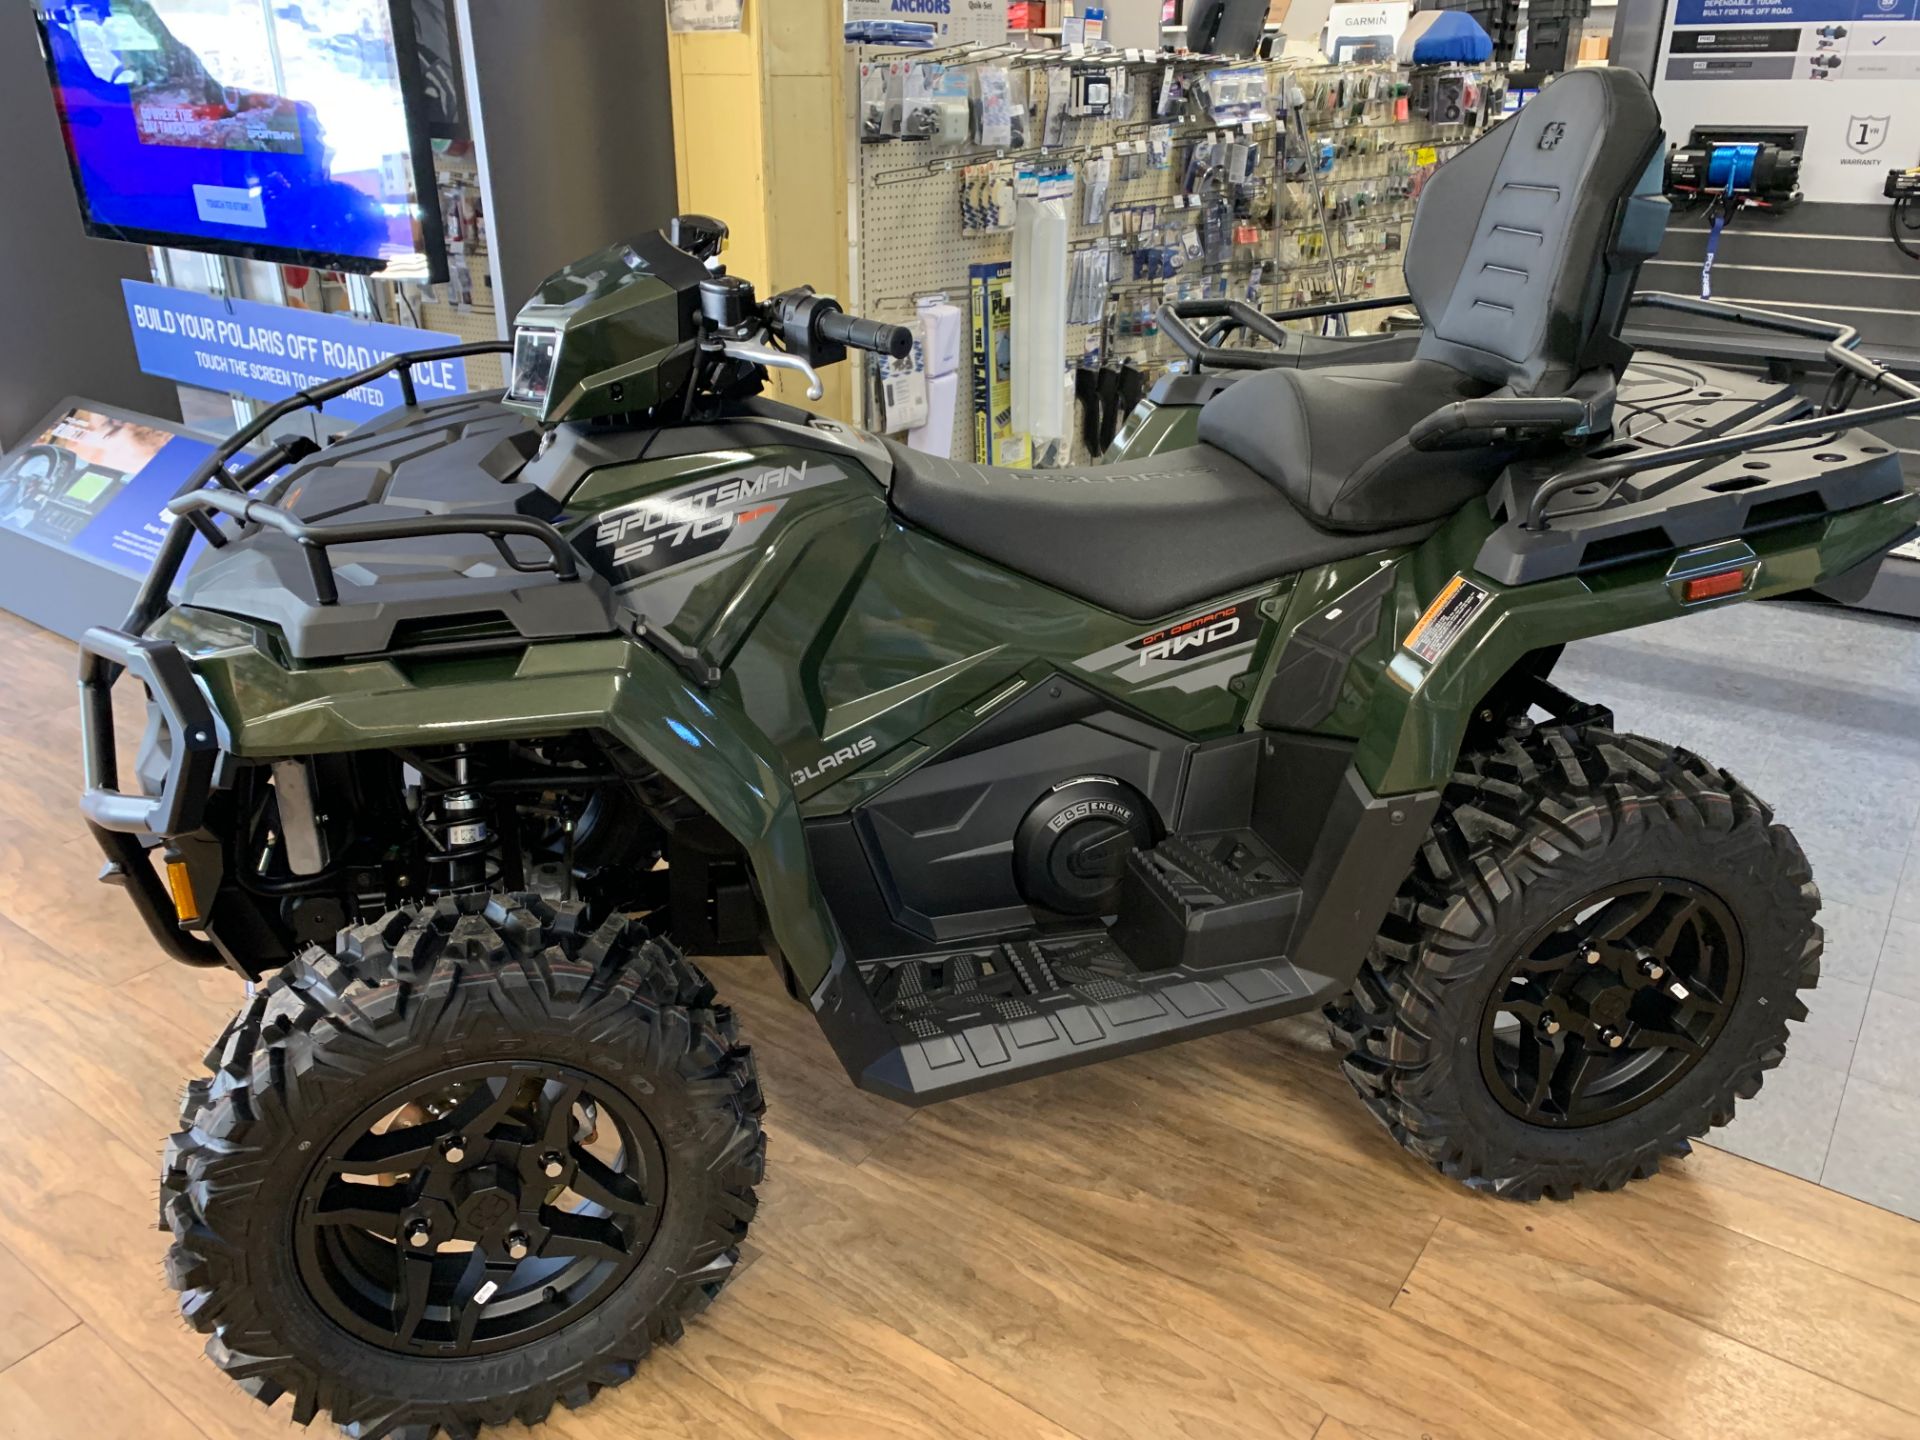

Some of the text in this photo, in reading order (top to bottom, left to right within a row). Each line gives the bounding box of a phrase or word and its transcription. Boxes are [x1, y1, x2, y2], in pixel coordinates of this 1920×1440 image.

[891, 0, 950, 14] ANCHORS
[1345, 16, 1387, 26] GARMIN
[1855, 124, 1868, 145] 1
[133, 304, 176, 334] BUILD
[176, 312, 217, 343] YOUR
[217, 320, 285, 356] POLARIS
[286, 333, 318, 363] OFF
[322, 340, 372, 372] ROAD
[974, 327, 983, 348] THE
[195, 351, 228, 372] TOUCH
[228, 358, 249, 378] THE
[250, 363, 292, 387] SCREEN
[291, 371, 308, 391] TO
[973, 351, 987, 414] PLANK
[596, 460, 807, 547] SPORTSMAN
[612, 511, 734, 567] 570
[1170, 607, 1236, 635] DEMAND
[1139, 617, 1240, 667] AWD
[790, 735, 877, 787] OLARIS
[1052, 802, 1132, 829] EBS ENGINE
